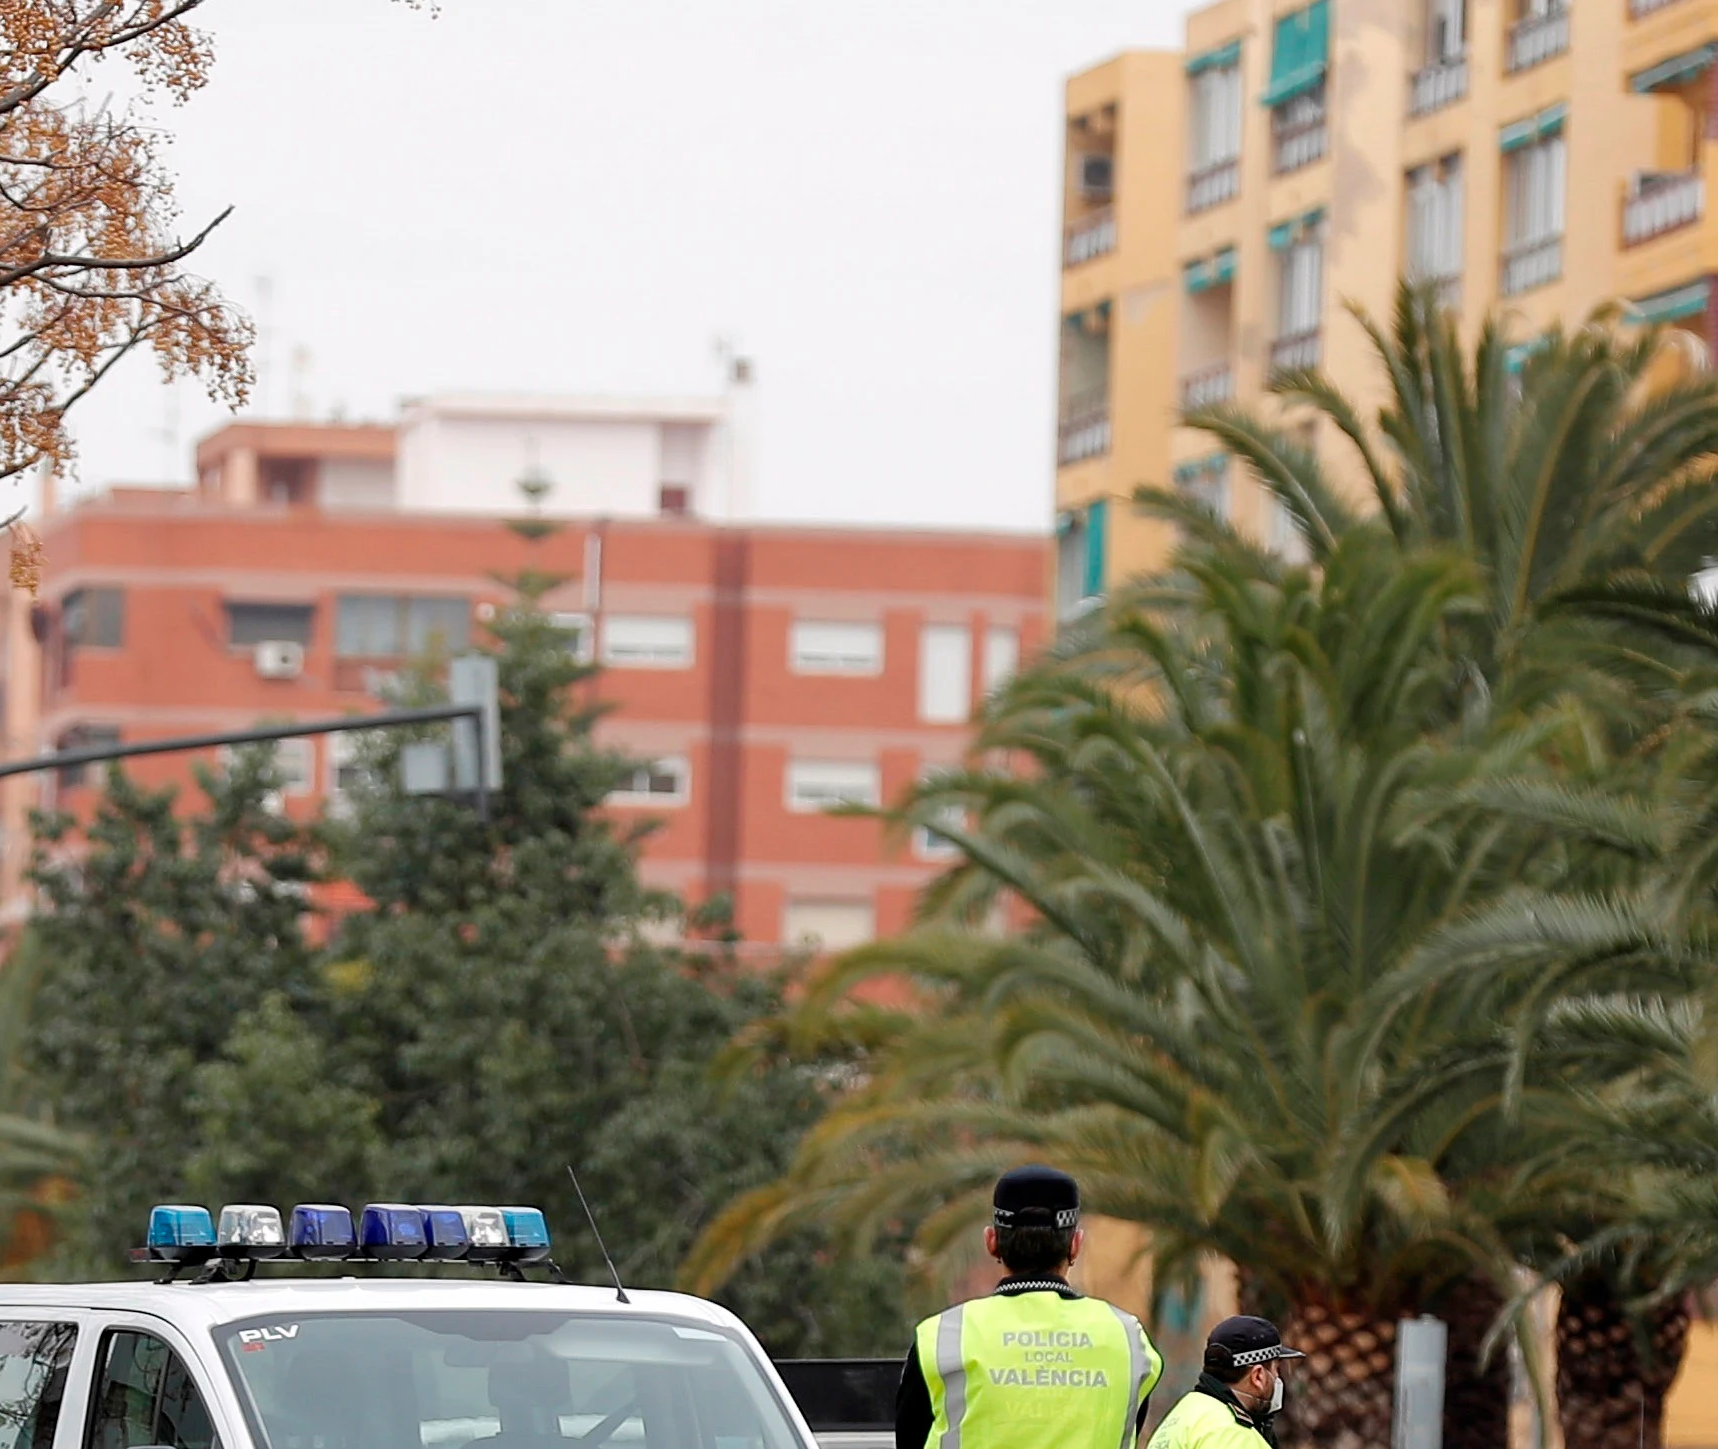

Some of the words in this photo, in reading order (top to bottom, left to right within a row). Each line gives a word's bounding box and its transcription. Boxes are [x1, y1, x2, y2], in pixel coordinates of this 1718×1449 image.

[238, 1323, 299, 1343] PLV
[1003, 1331, 1093, 1348] POLICIA
[1024, 1351, 1073, 1363] LOCAL
[989, 1365, 1108, 1388] VALÈNCIA
